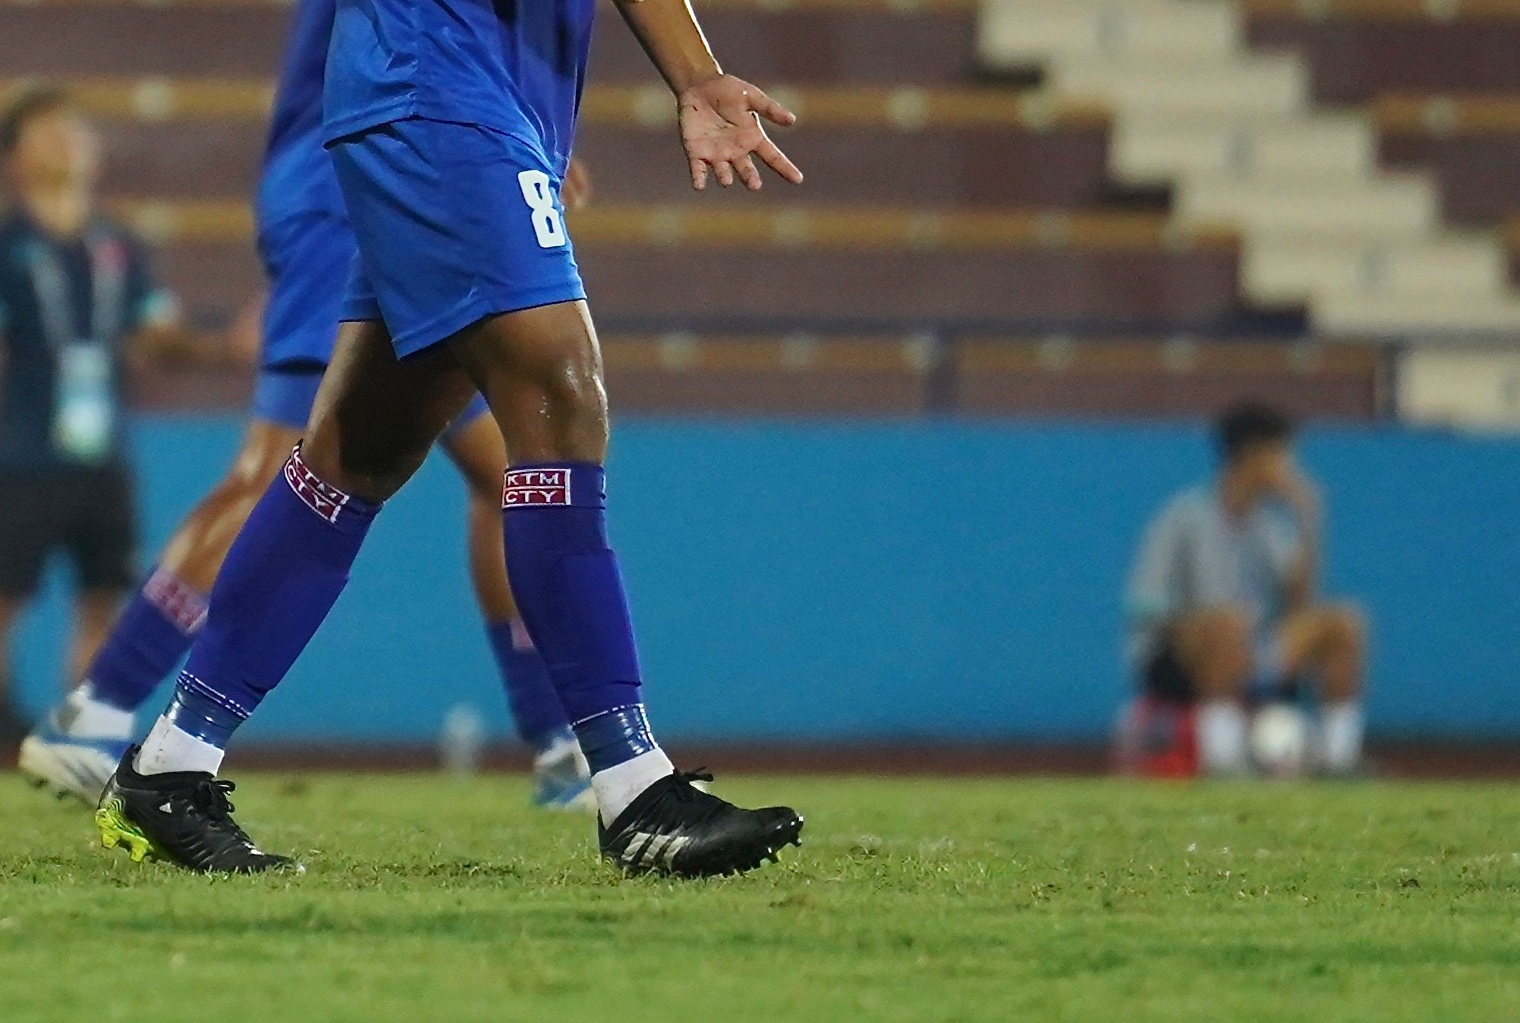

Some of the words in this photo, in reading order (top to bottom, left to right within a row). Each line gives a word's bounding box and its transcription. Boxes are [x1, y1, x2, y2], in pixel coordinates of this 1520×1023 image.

[517, 169, 566, 248] 8
[287, 464, 330, 509] CTY
[507, 472, 560, 486] KTM
[505, 490, 559, 503] CTY
